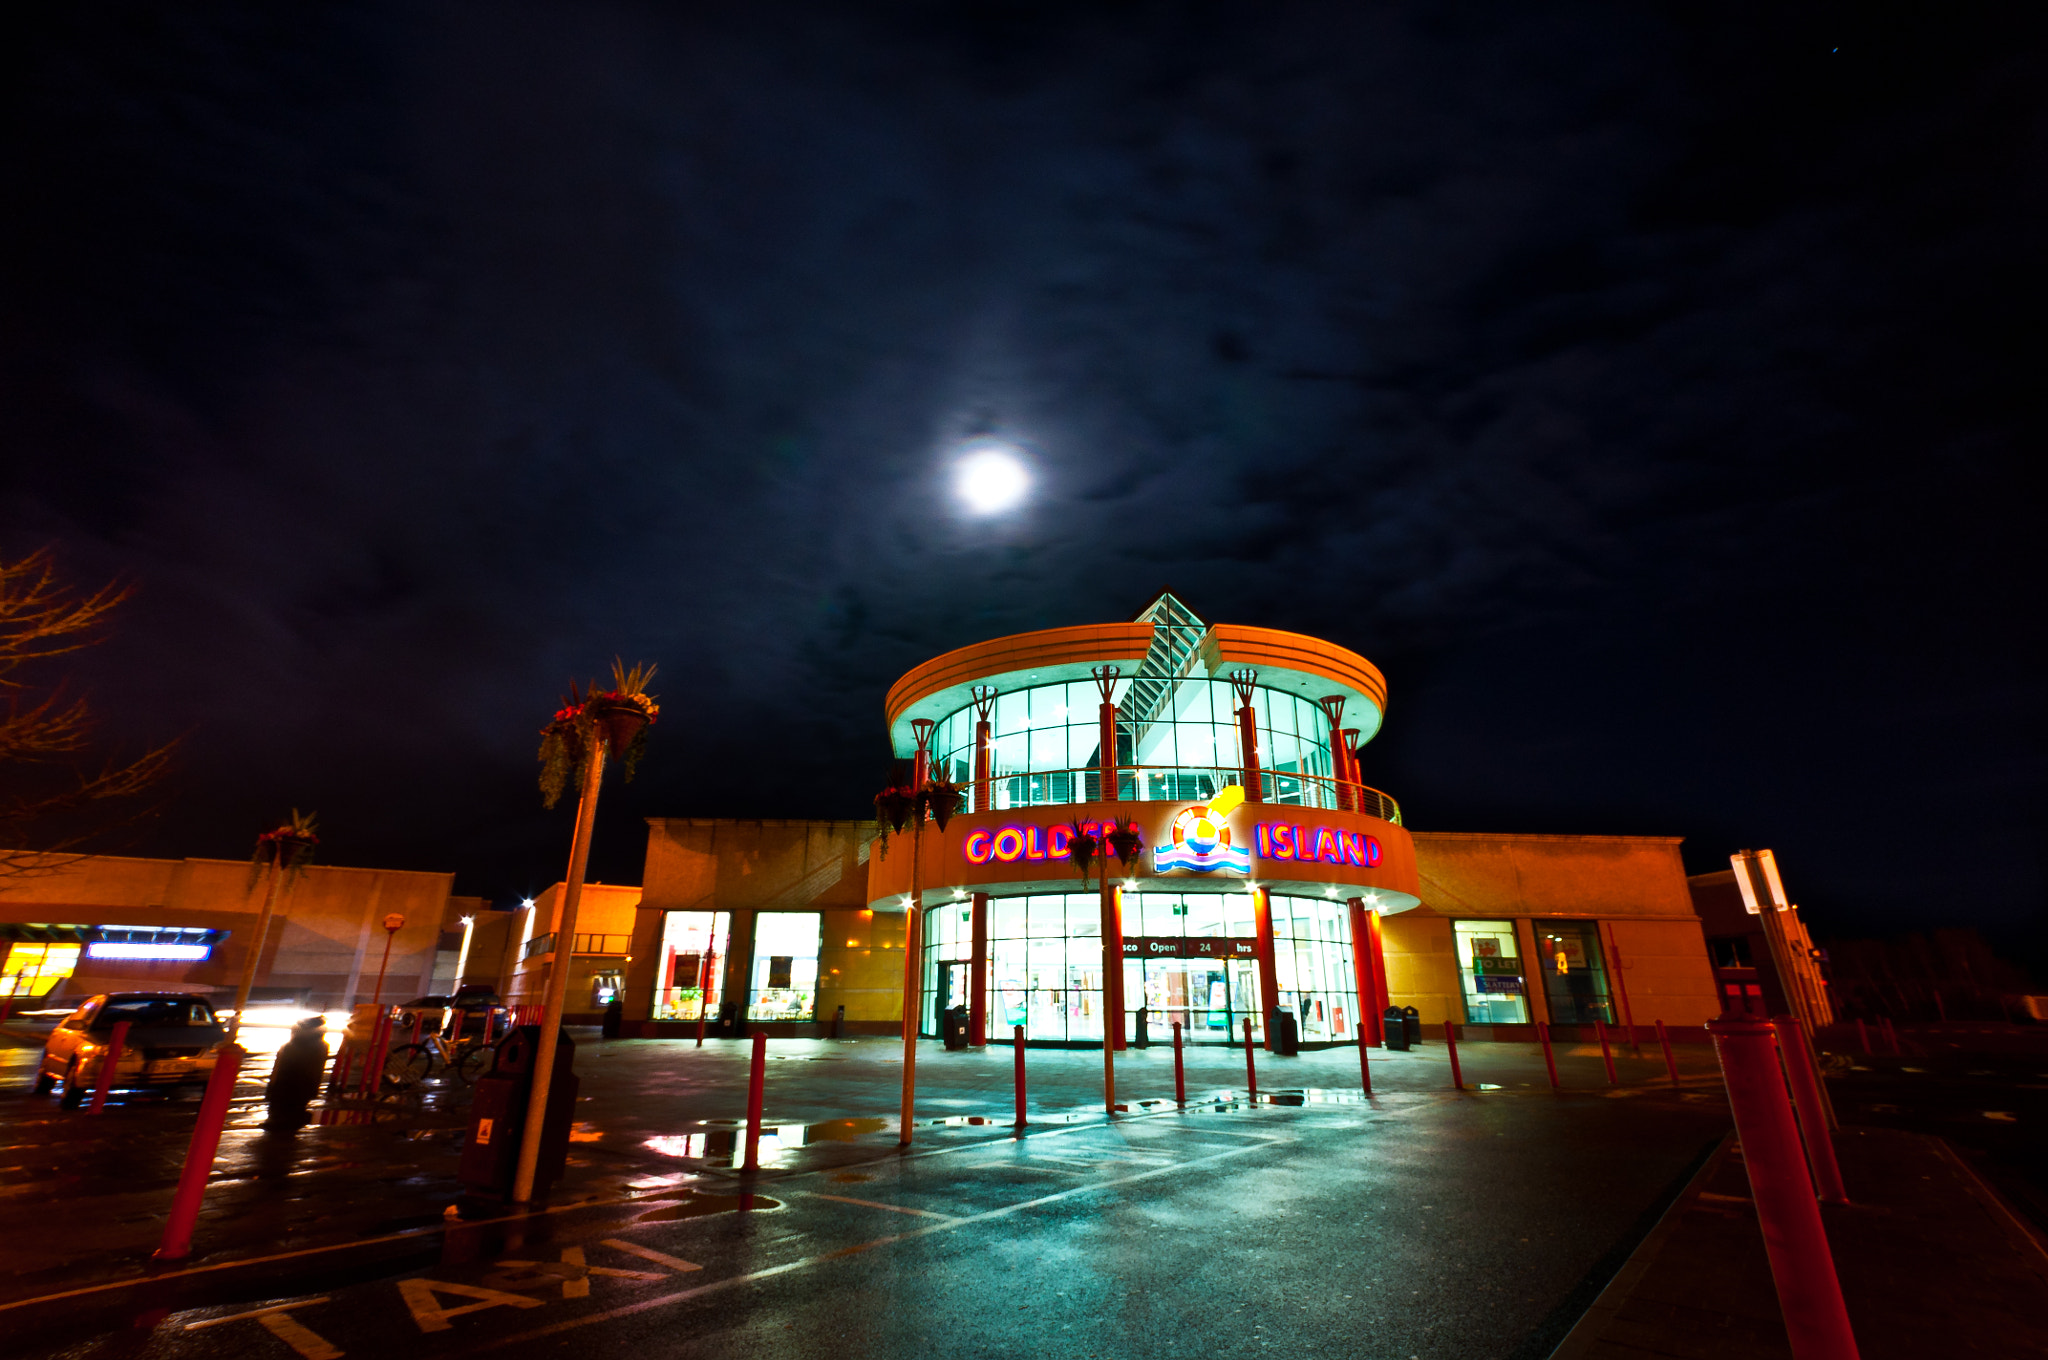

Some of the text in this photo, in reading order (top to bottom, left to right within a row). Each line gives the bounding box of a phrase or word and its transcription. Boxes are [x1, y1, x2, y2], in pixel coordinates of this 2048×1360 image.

[1257, 823, 1383, 867] ISLAND
[1150, 942, 1176, 953] Open
[1199, 943, 1211, 952] 24
[1236, 943, 1252, 953] hrs
[1497, 960, 1517, 969] LET
